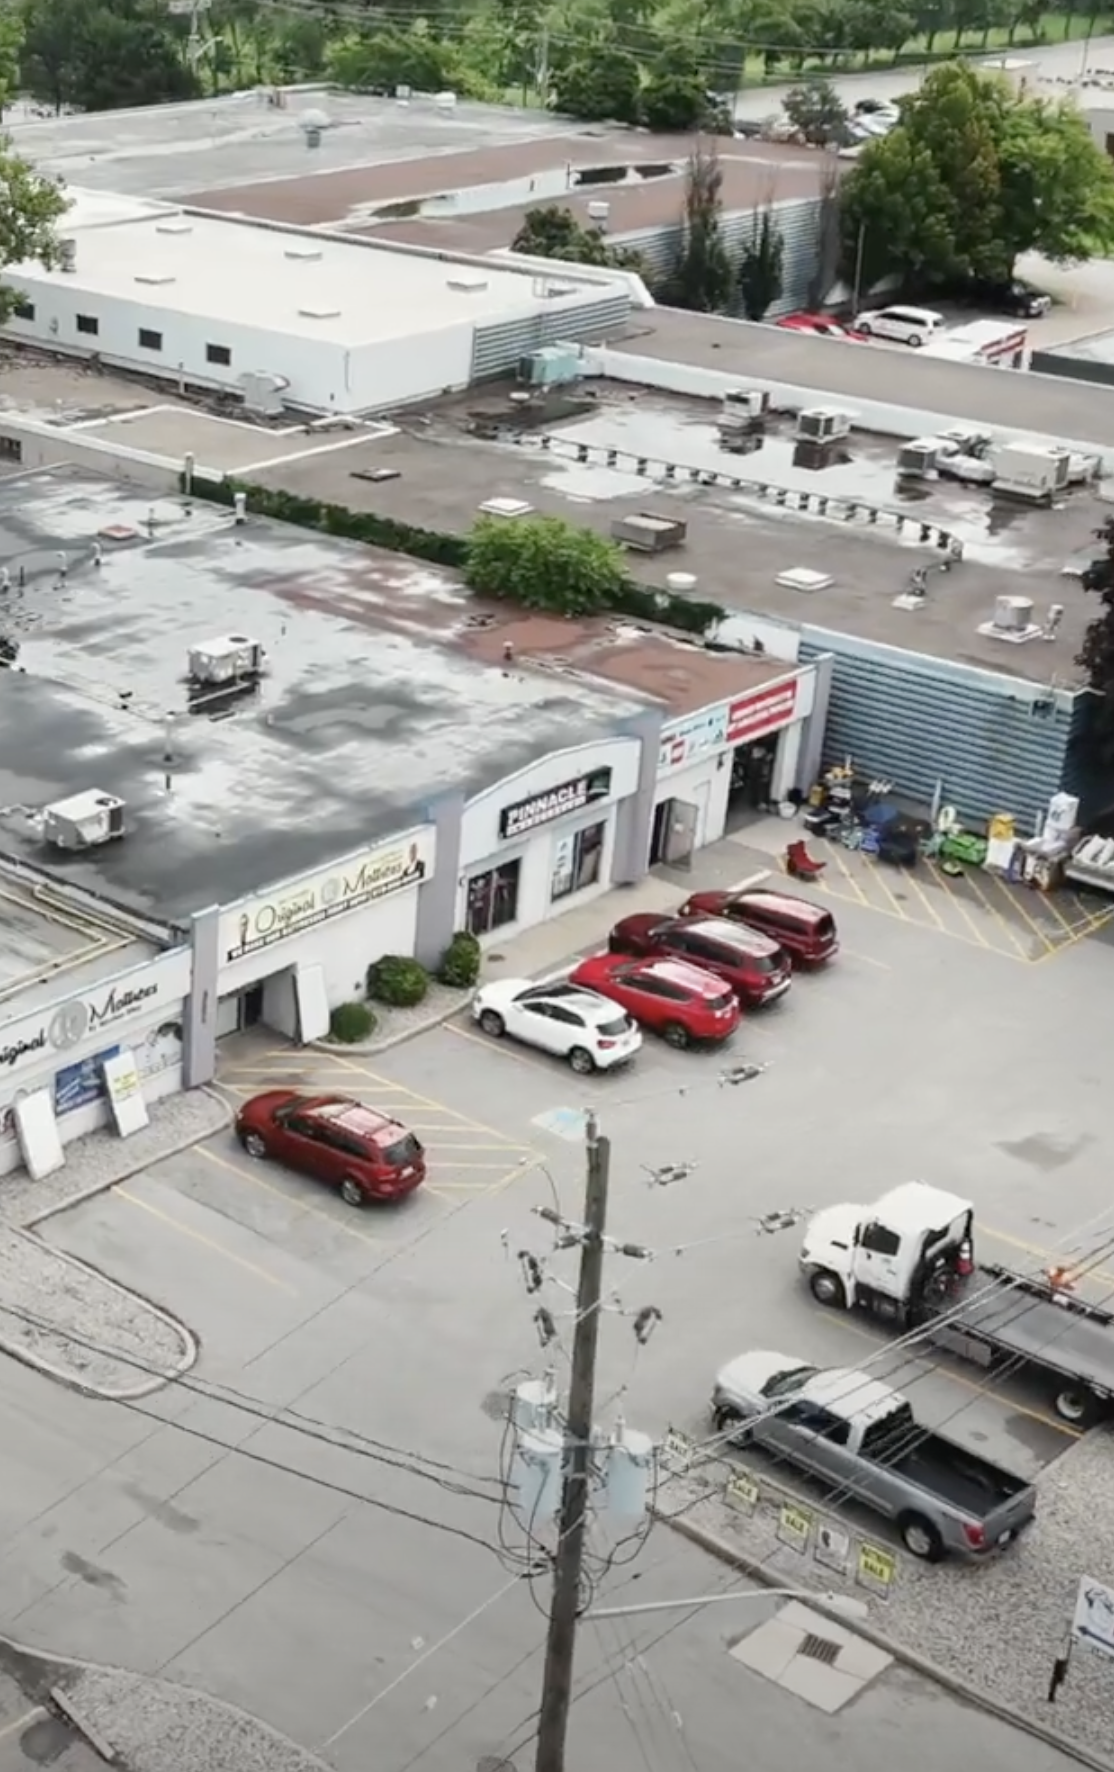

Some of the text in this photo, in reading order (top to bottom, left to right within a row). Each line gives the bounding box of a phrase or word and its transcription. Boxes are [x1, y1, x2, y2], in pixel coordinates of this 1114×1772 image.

[508, 780, 587, 825] PINNACLE
[255, 891, 315, 935] Original
[863, 1558, 885, 1579] SALE
